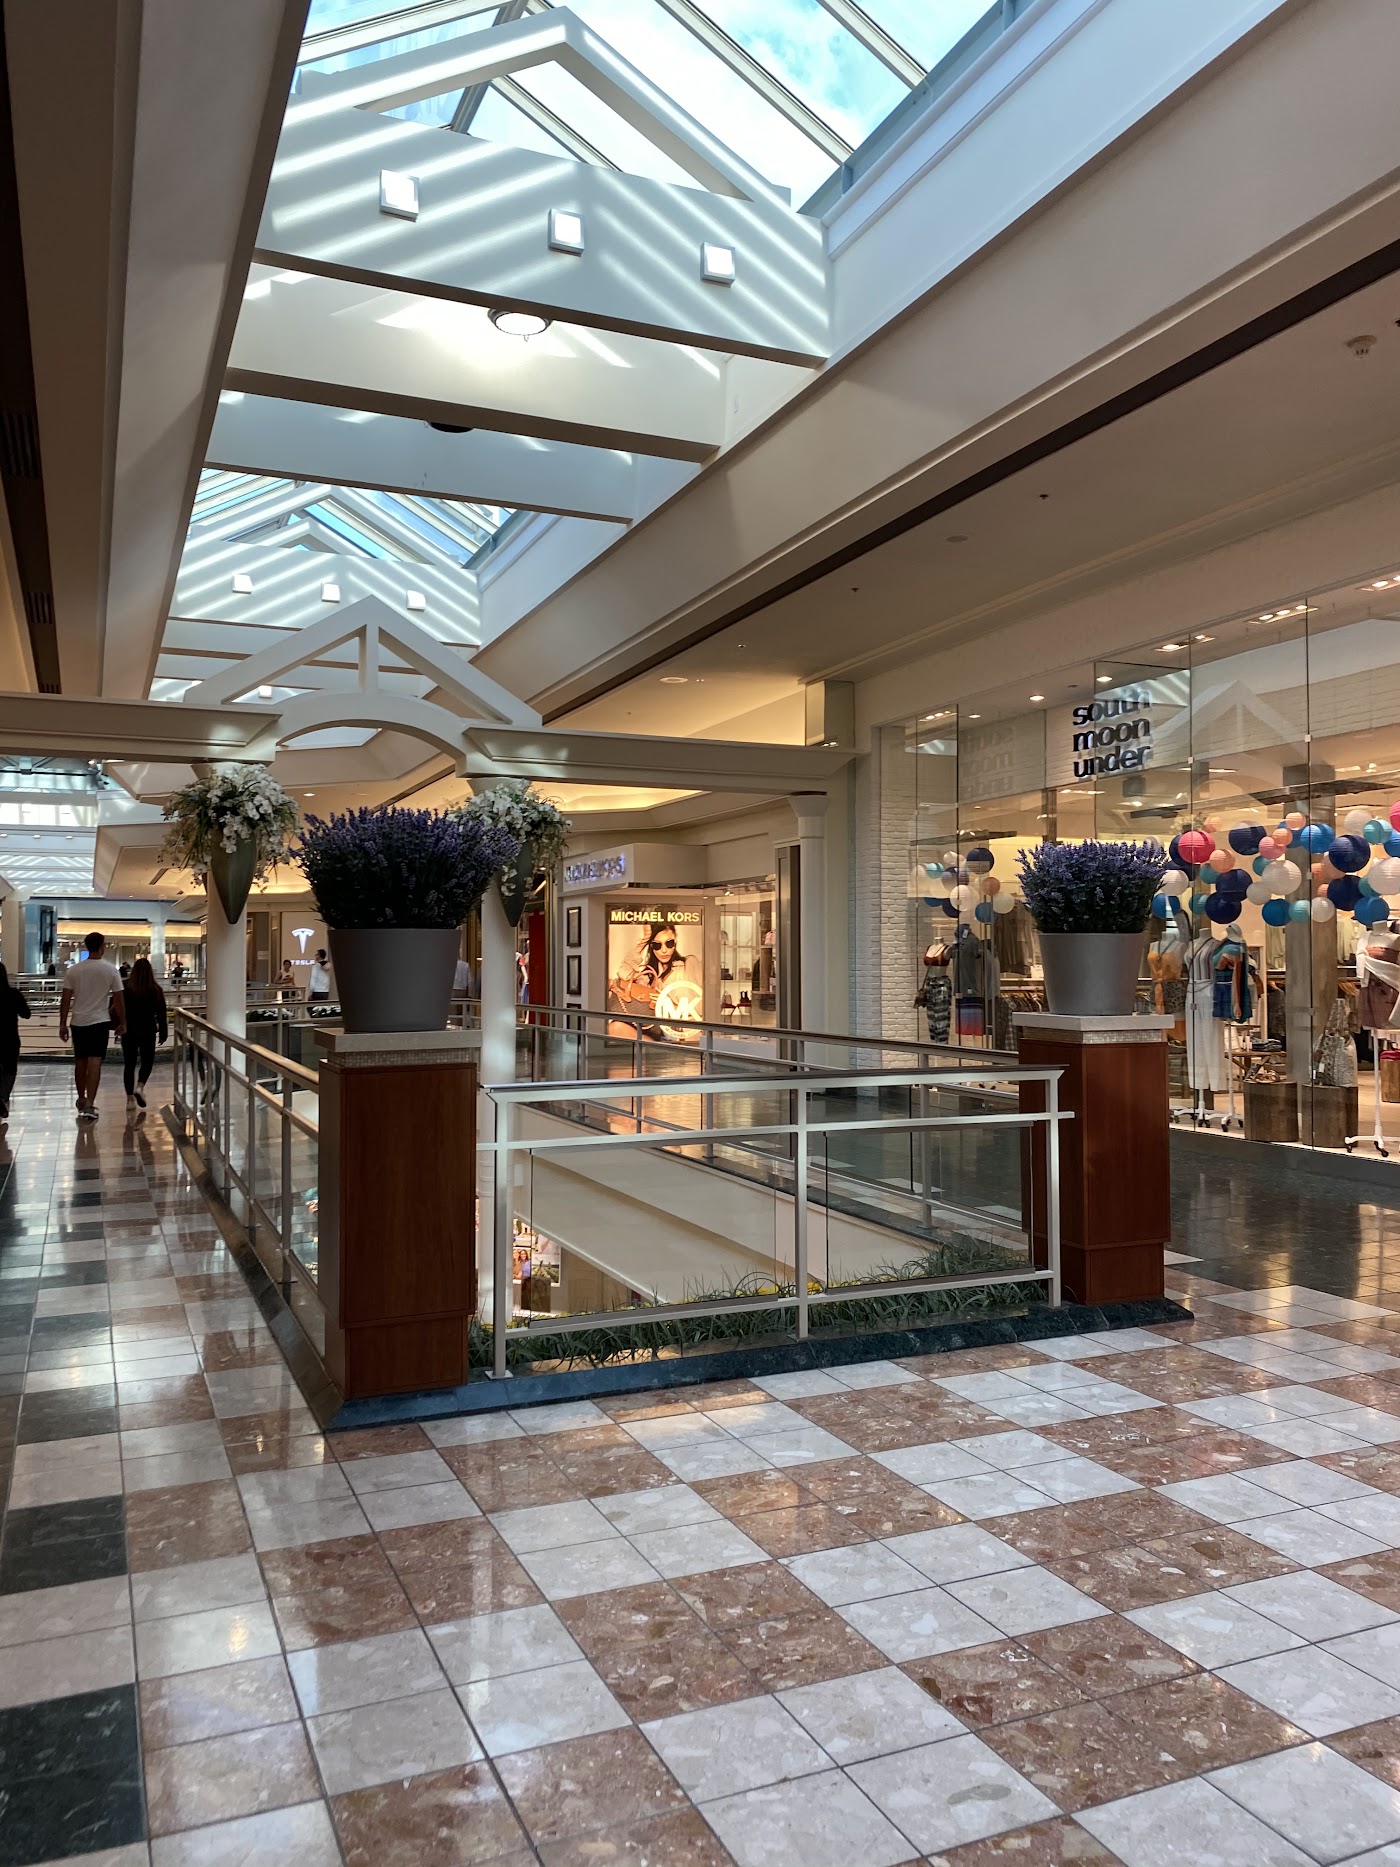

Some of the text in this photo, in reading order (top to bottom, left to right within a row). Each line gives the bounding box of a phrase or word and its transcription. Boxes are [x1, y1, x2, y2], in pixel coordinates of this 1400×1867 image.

[1073, 686, 1151, 725] south
[1073, 718, 1151, 752] moon
[1073, 746, 1151, 777] under
[611, 911, 700, 922] MICHAEL KORS
